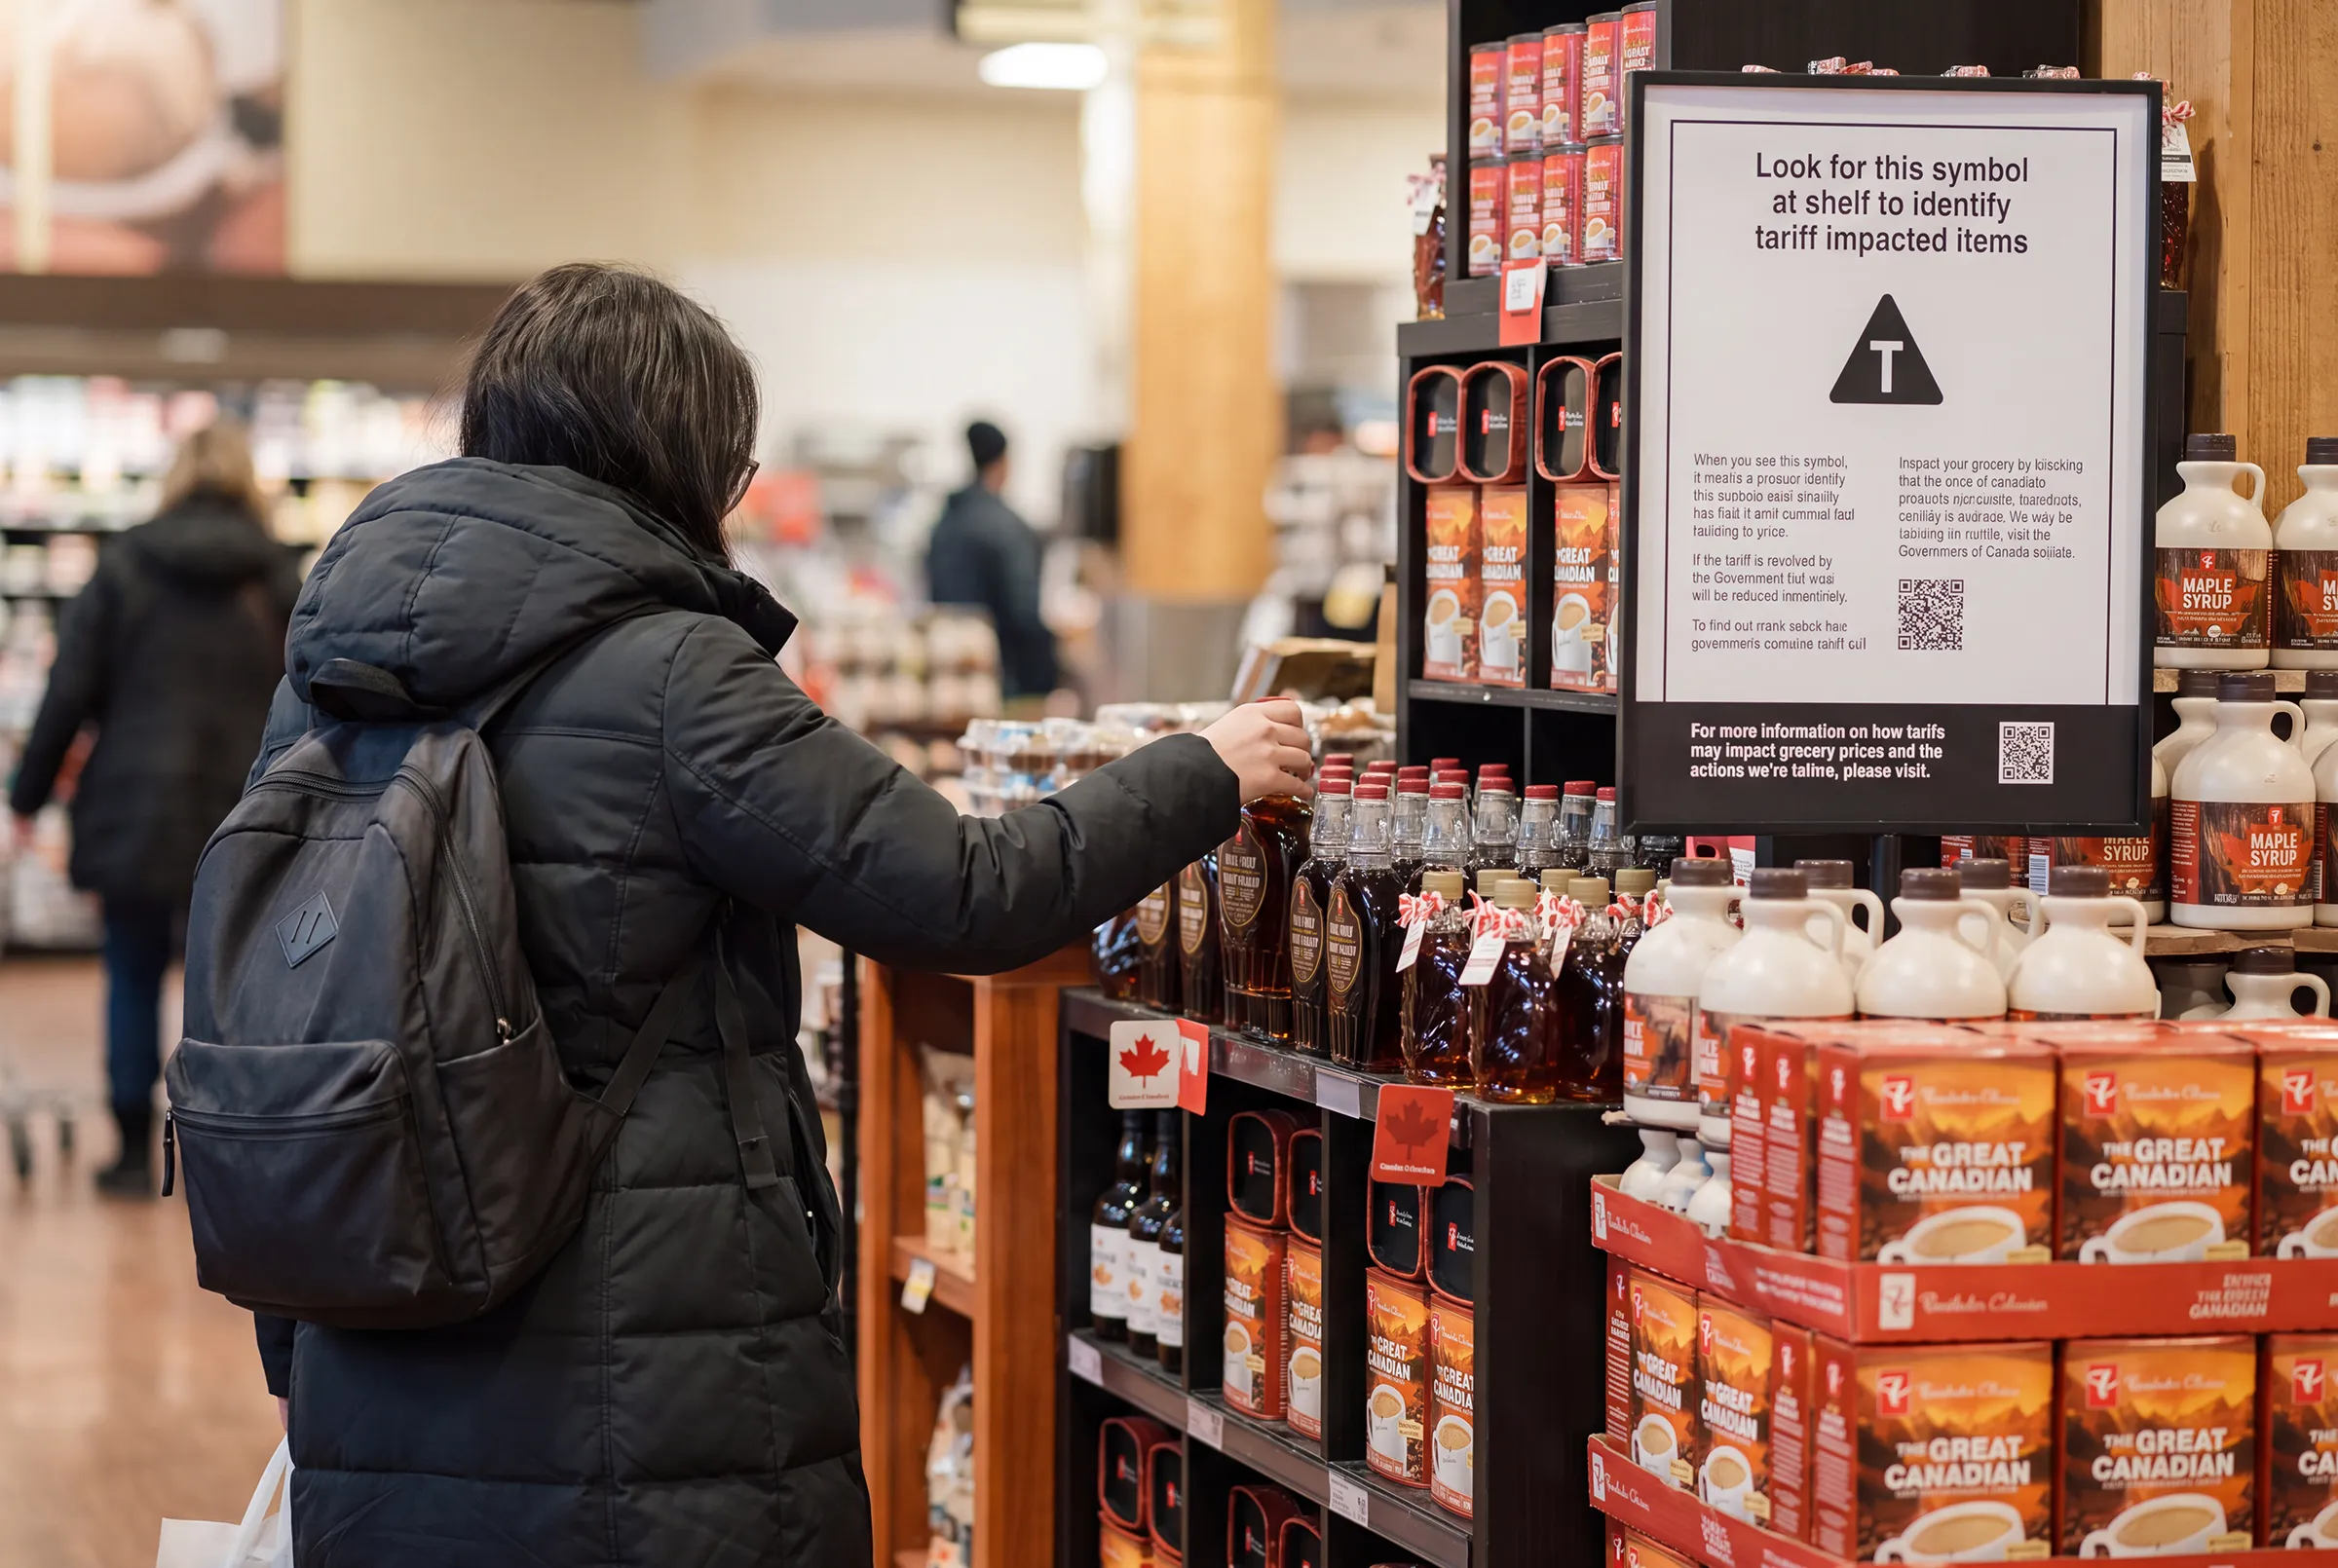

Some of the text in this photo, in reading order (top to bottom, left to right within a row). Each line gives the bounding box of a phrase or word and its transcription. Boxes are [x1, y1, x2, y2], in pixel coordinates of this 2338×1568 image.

[1757, 153, 2027, 187] Look for this symbol
[1773, 189, 2011, 224] at shelf to identify
[1755, 224, 2027, 257] tariff impacted items
[1870, 341, 1904, 392] T
[1694, 454, 1847, 469] When you see this symbol,
[1900, 457, 1940, 471] Inspact
[1943, 461, 1968, 472] your
[1972, 461, 2014, 473] grocery
[2018, 459, 2031, 473] by
[1694, 471, 1700, 483] it
[1747, 475, 1753, 484] a
[1900, 474, 2046, 488] that the once of canadiato
[1694, 489, 1714, 501] this
[1694, 507, 1714, 519] has
[1744, 507, 1751, 519] it
[1945, 510, 1953, 522] is
[2010, 510, 2028, 522] We
[2059, 511, 2072, 523] be
[1743, 526, 1753, 537] to
[2008, 529, 2029, 541] visit
[2033, 529, 2050, 541] the
[1561, 546, 1591, 565] GREAT
[1972, 545, 1982, 557] of
[1986, 545, 2029, 557] Canada
[1693, 554, 1832, 570] If the tariff is revolved by
[1693, 572, 1710, 583] the
[2183, 579, 2233, 593] MAPLE
[1692, 589, 1710, 600] will
[1715, 589, 1728, 601] be
[1732, 590, 1778, 601] reduced
[2322, 579, 2338, 595] M
[2183, 594, 2233, 610] SYRUP
[1692, 619, 1706, 631] To
[1710, 619, 1730, 631] find
[1735, 620, 1753, 631] out
[1691, 723, 1944, 739] For more information on how tarifs
[1691, 742, 1942, 762] may impact grecery prices and the
[1690, 763, 1744, 777] actions
[1748, 763, 1788, 777] we're
[1844, 763, 1891, 781] please
[1895, 763, 1930, 778] visit.
[2250, 833, 2297, 849] MAPLE
[2103, 845, 2149, 861] SYRUP
[2250, 850, 2297, 866] SYRUP
[1932, 1141, 2026, 1167] GREAT
[2134, 1138, 2226, 1163] GREAT
[1887, 1167, 2032, 1194] CANADIAN
[2091, 1163, 2232, 1189] CANADIAN
[1376, 1336, 1408, 1362] GREAT
[1368, 1349, 1411, 1381] CANADIAN
[1646, 1353, 1678, 1385] GREAT
[1434, 1379, 1474, 1409] CANADIA
[1634, 1368, 1682, 1410] CANADIAN
[1716, 1382, 1754, 1415] GREAT
[1701, 1399, 1757, 1441] CANADIAN
[1928, 1436, 2023, 1462] GREAT
[2135, 1428, 2228, 1455] GREAT
[2092, 1452, 2235, 1481] CANADIAN
[2297, 1450, 2338, 1476] CA
[1884, 1460, 2031, 1490] CANADIAN
